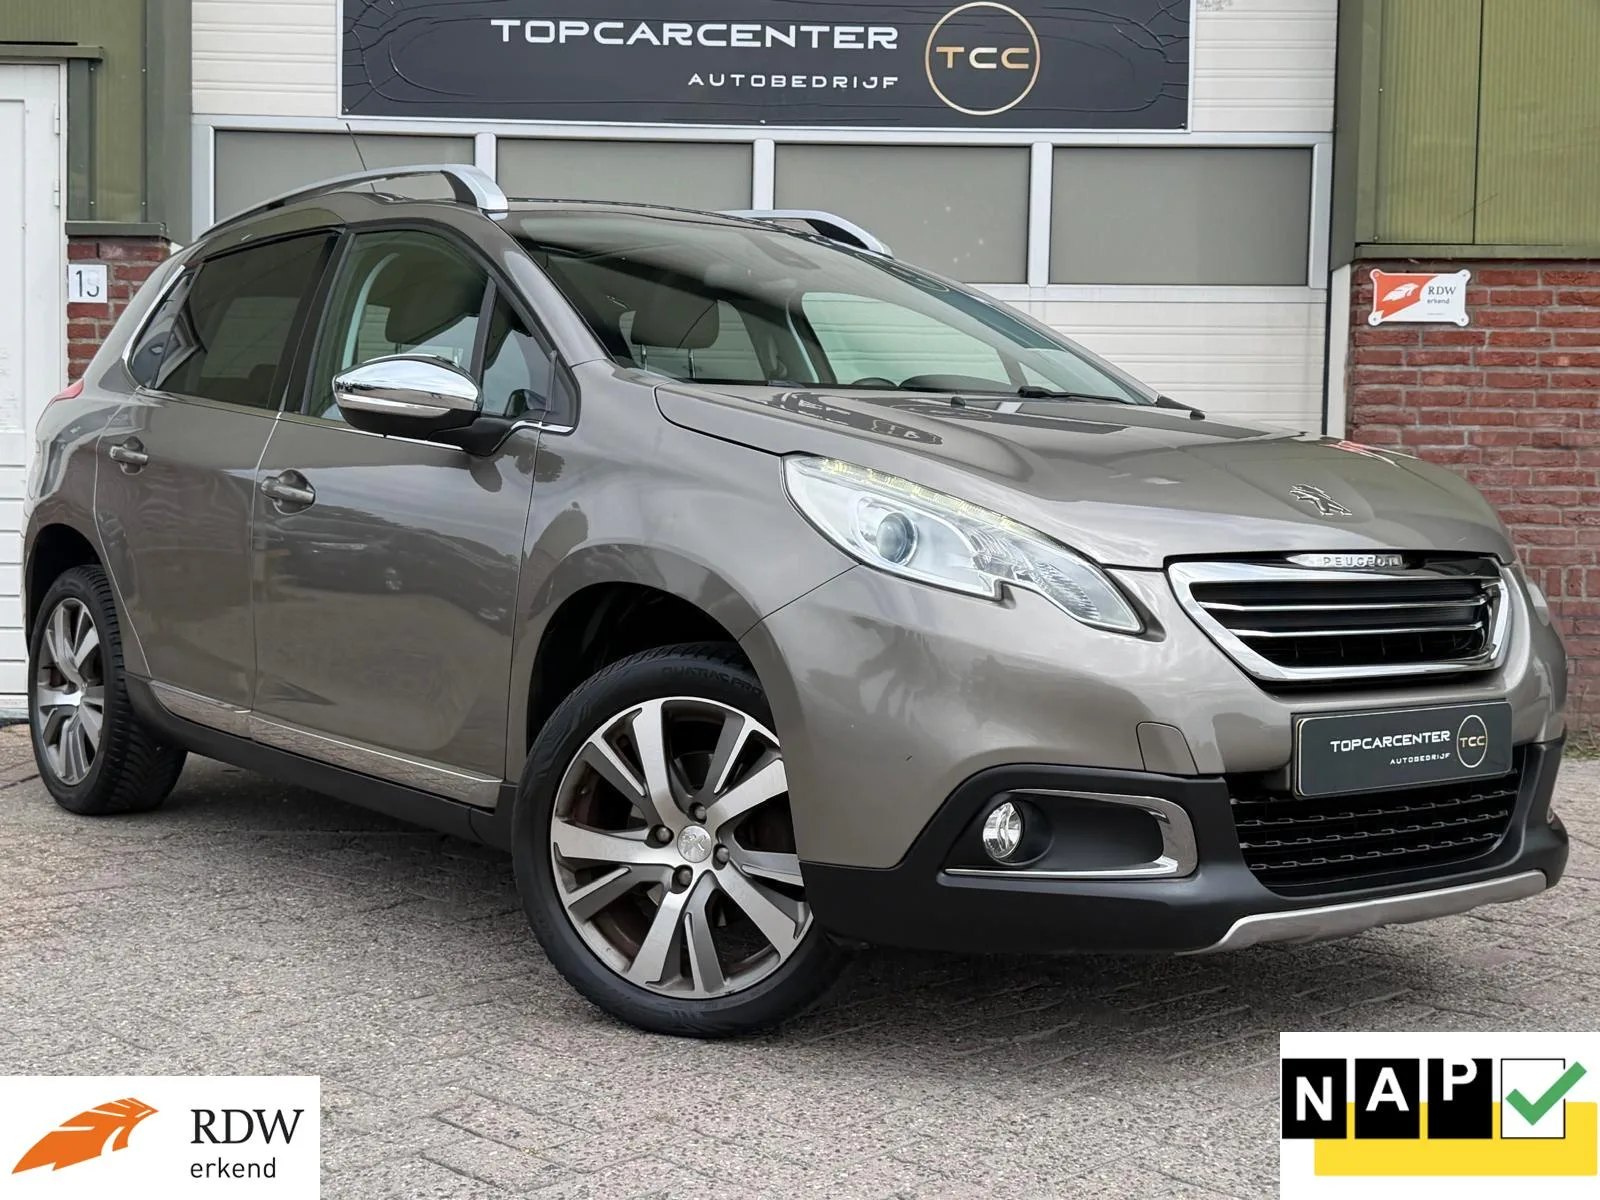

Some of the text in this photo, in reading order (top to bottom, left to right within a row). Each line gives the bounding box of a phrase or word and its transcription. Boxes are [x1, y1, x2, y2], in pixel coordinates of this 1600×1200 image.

[490, 18, 899, 51] TOPCARCENTER
[935, 46, 1030, 69] TCC
[688, 72, 899, 89] AUTOBEDRIJF
[1427, 286, 1457, 296] RDW
[1323, 556, 1397, 567] PEUGEOT
[1330, 730, 1451, 752] TOPCARCENTER
[1459, 735, 1486, 748] TCC
[1390, 752, 1451, 764] AUTOBEDRIJF
